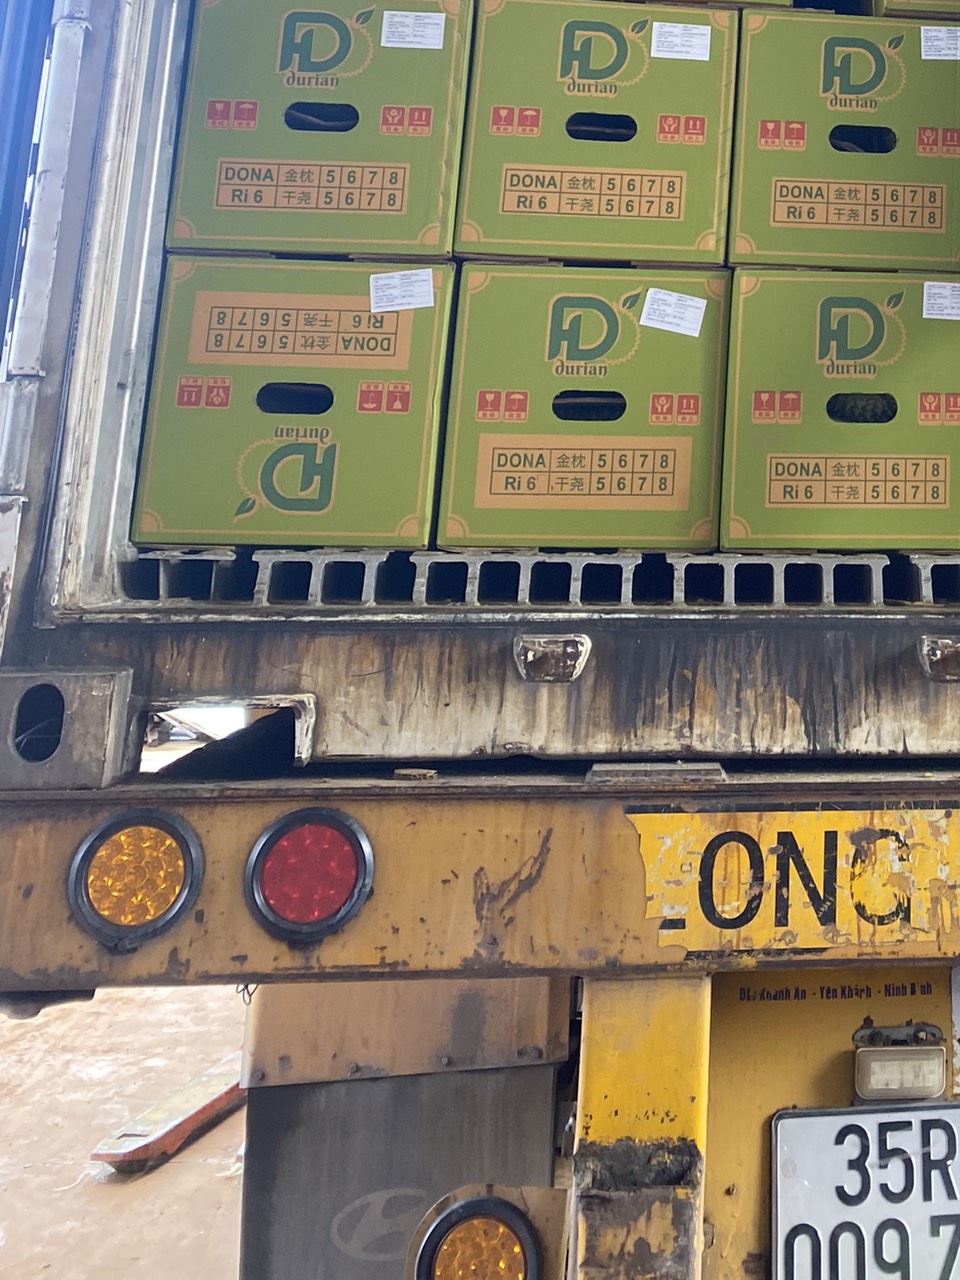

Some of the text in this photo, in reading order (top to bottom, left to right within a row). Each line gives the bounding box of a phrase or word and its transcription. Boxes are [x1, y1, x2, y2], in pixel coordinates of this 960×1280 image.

[287, 72, 340, 88] durian
[567, 78, 618, 95] durian
[830, 94, 877, 109] durian
[509, 173, 675, 193] DONA 金枕 5 6 7 8
[516, 195, 533, 209] Ri
[538, 196, 547, 209] 6
[605, 199, 614, 211] 5
[625, 200, 634, 212] 6
[646, 200, 654, 213] 7
[665, 201, 673, 214] 8
[556, 359, 608, 375] durian
[827, 359, 876, 376] durian
[774, 462, 939, 477] DONA 金枕 5 6 7 8
[783, 485, 798, 499] Ri
[804, 485, 812, 499] 6
[871, 486, 879, 499] 5
[891, 486, 899, 499] 6
[911, 486, 920, 499] 7
[931, 486, 939, 499] 8
[647, 829, 911, 930] ONG
[884, 983, 907, 997] Ninh
[910, 981, 932, 996] Bnh
[834, 1118, 960, 1206] 35R
